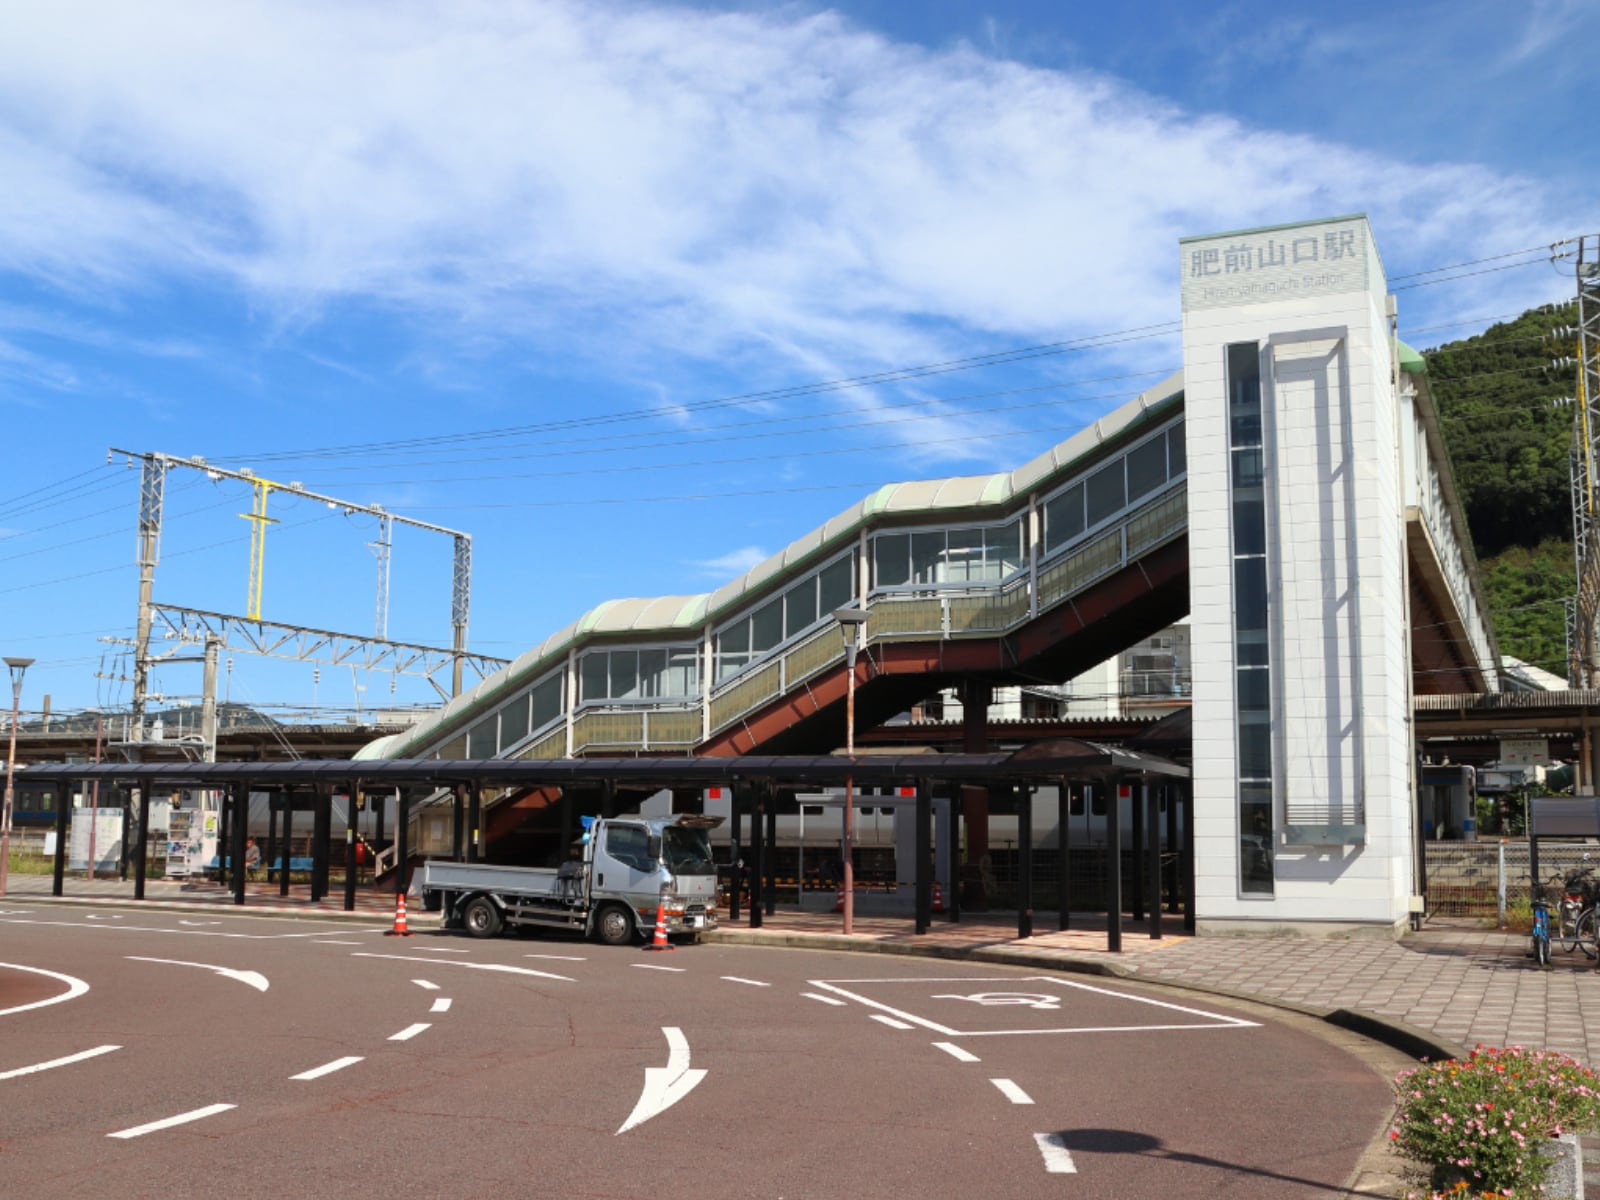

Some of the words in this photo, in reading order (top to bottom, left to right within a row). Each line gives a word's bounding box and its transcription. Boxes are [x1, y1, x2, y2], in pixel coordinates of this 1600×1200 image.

[1191, 229, 1356, 277] 肥前山口駅
